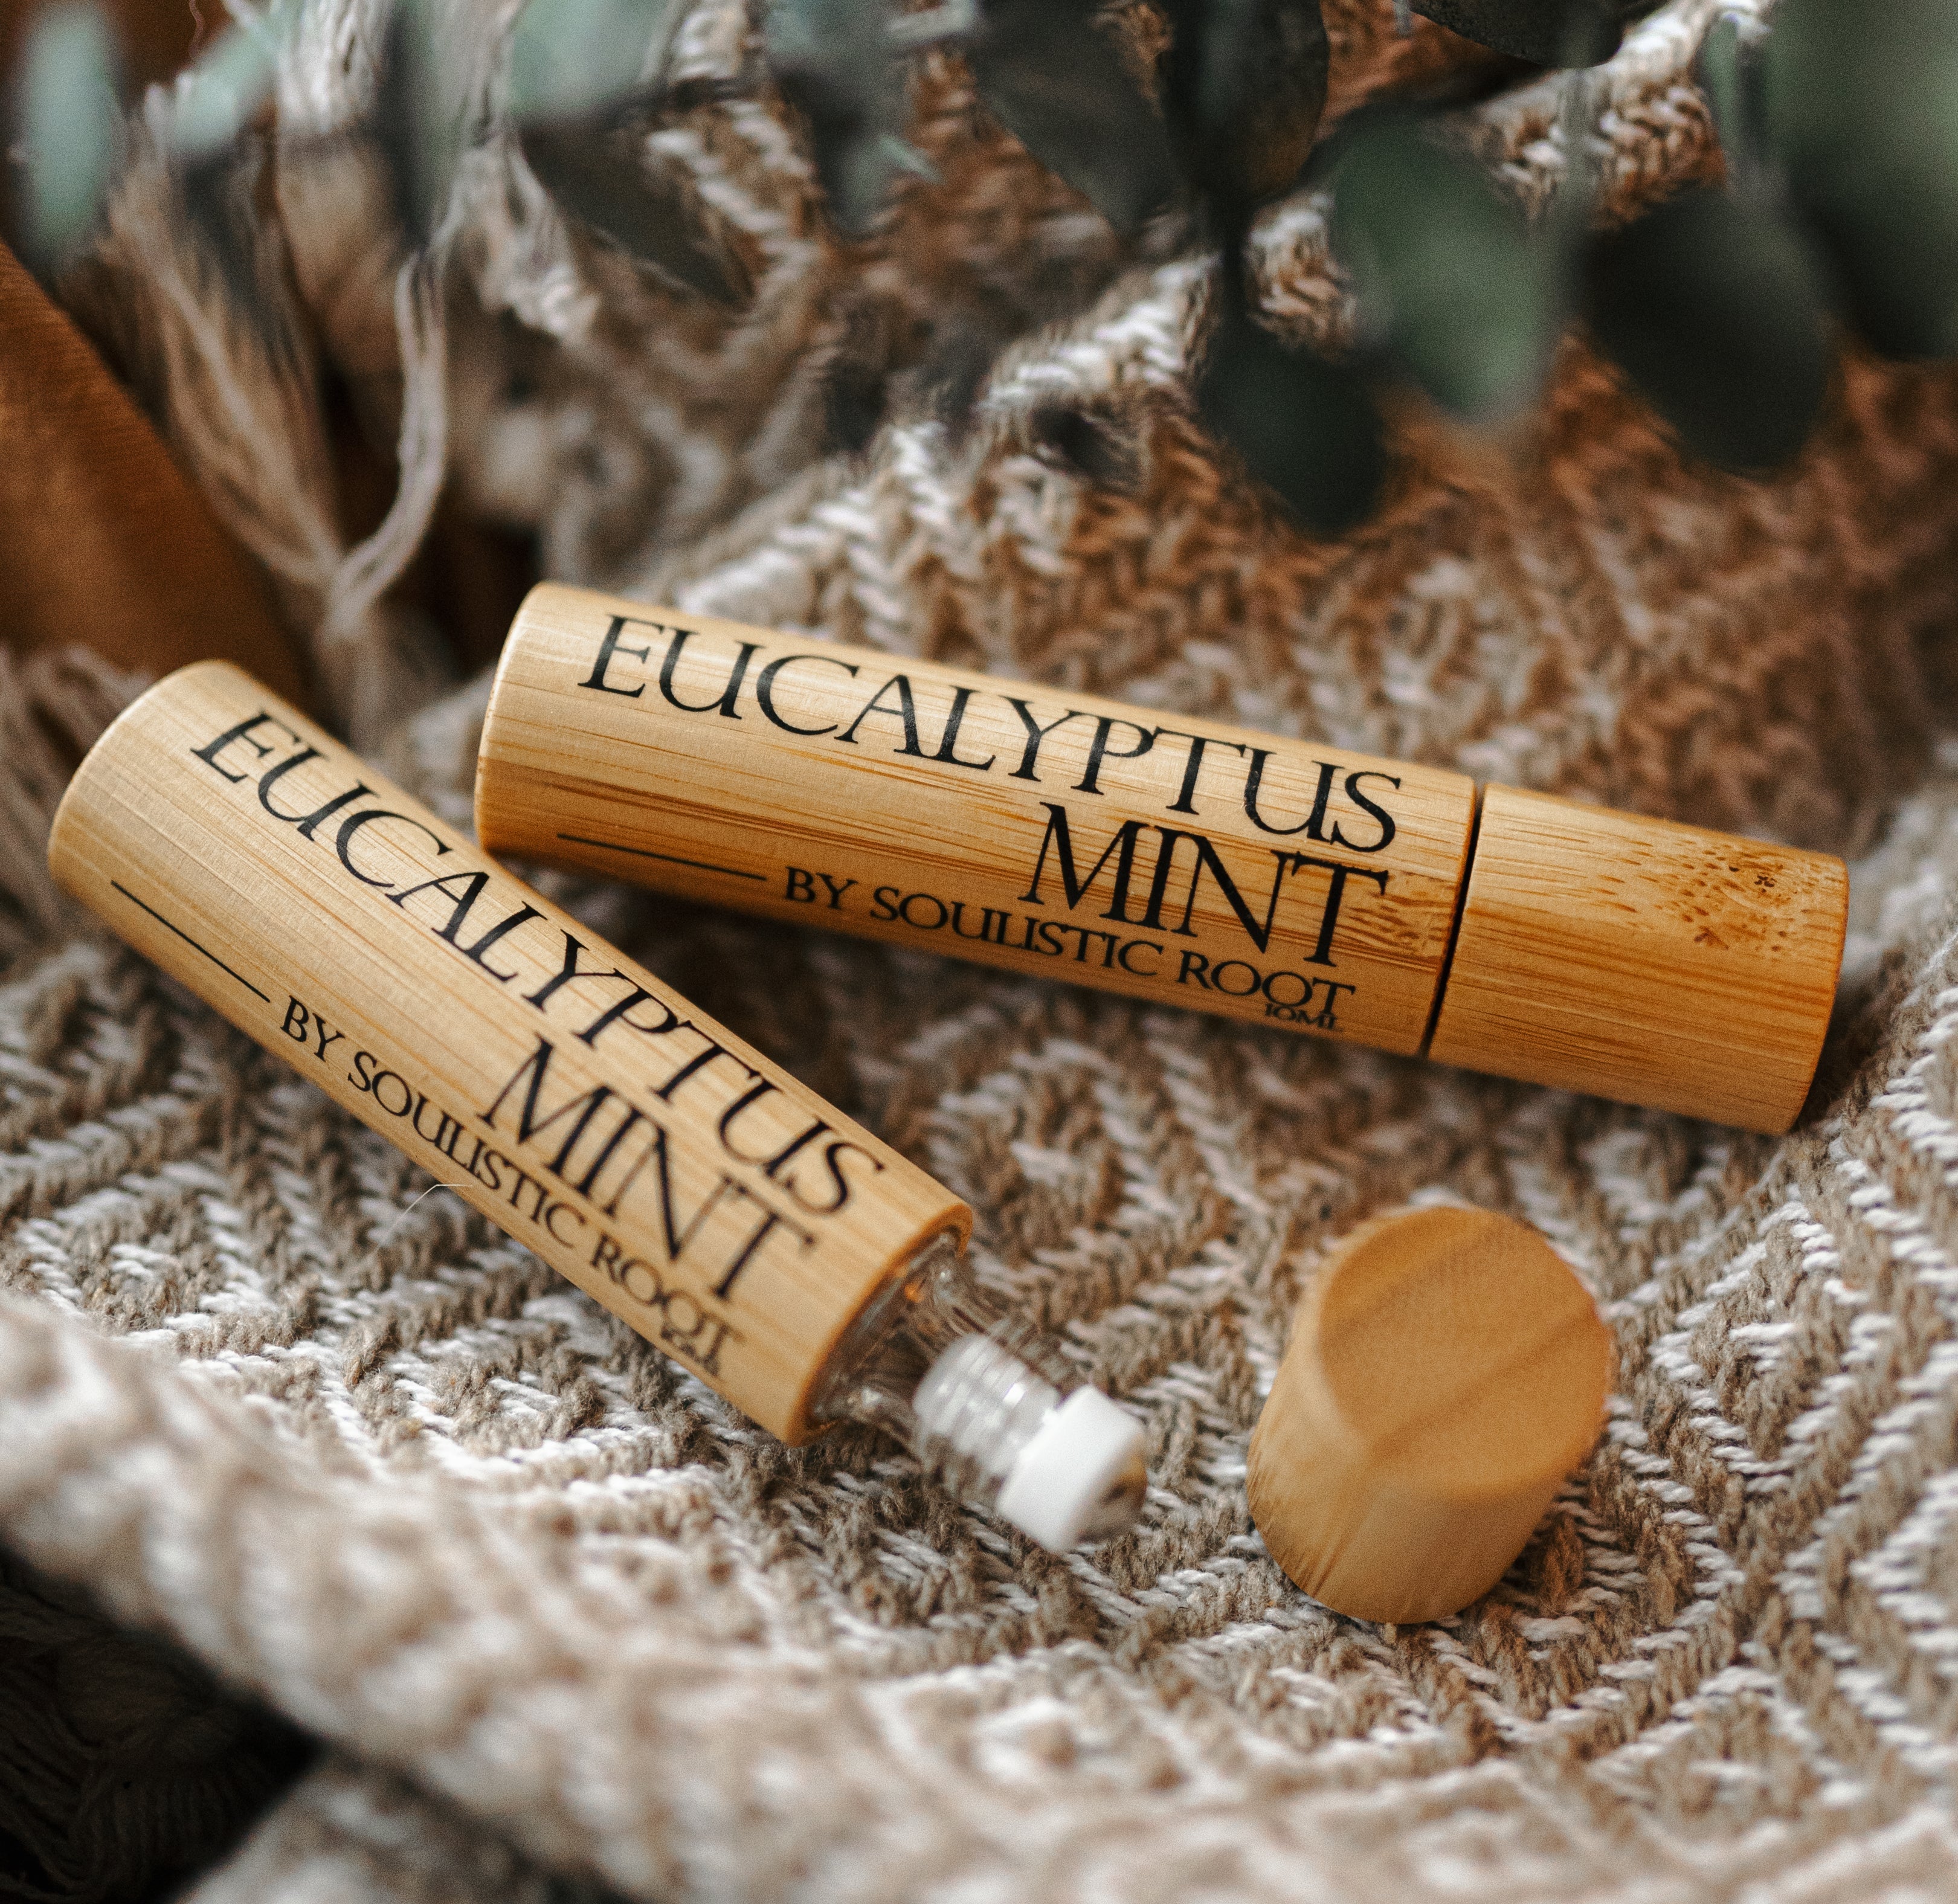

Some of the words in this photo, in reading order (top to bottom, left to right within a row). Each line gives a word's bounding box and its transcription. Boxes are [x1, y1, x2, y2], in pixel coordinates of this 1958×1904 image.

[578, 614, 1402, 853] EUCALYPTUS
[190, 711, 885, 1216] EUCALYPTUS
[785, 866, 858, 910] BY
[869, 886, 1164, 976] SOULISTIC
[1176, 950, 1356, 1015] ROOT
[1017, 801, 1388, 967] MINT
[280, 995, 345, 1062] BY
[347, 1051, 587, 1249] SOULISTIC
[590, 1231, 746, 1364] ROOT
[477, 1032, 818, 1303] MINT
